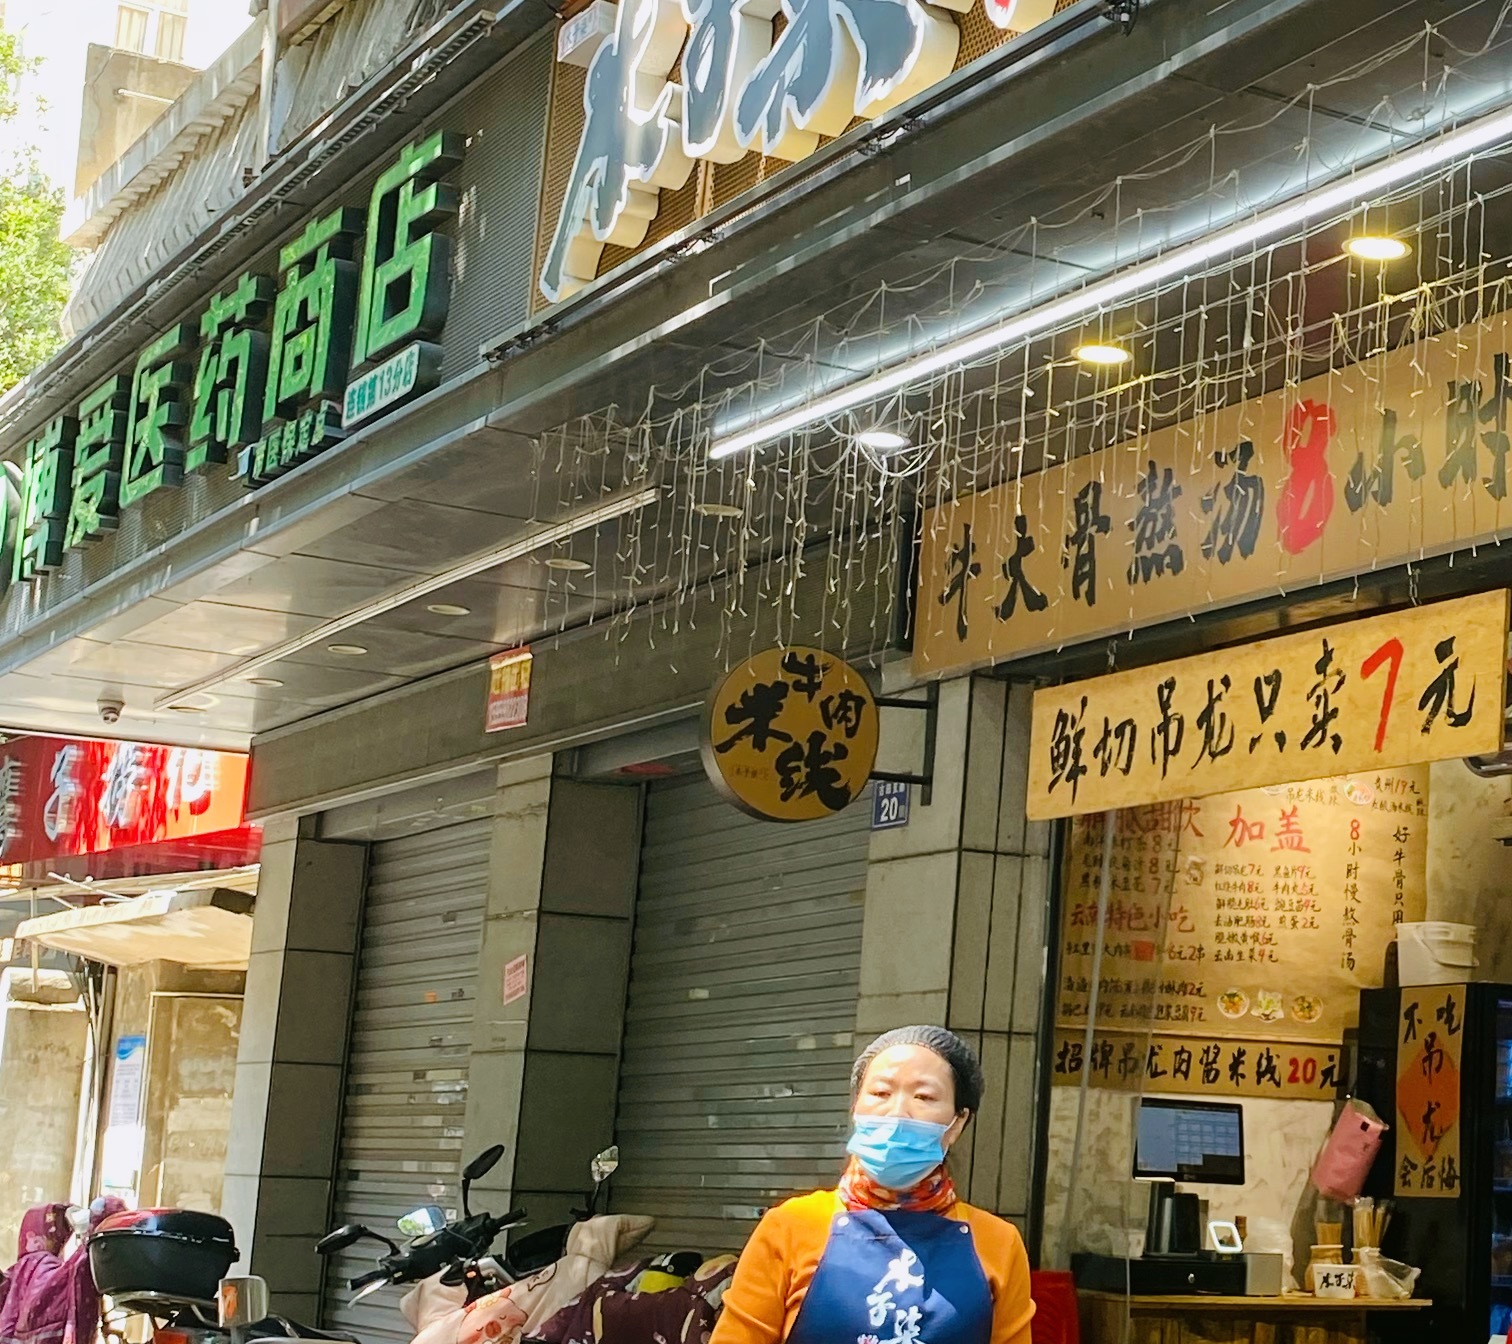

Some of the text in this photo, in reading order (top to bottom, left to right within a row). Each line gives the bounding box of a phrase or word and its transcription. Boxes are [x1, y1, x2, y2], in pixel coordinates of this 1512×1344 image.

[1048, 636, 1476, 805] 鲜切吊龙只卖7元
[1223, 803, 1312, 854] 加盖
[1391, 824, 1411, 940] 好牛骨只用
